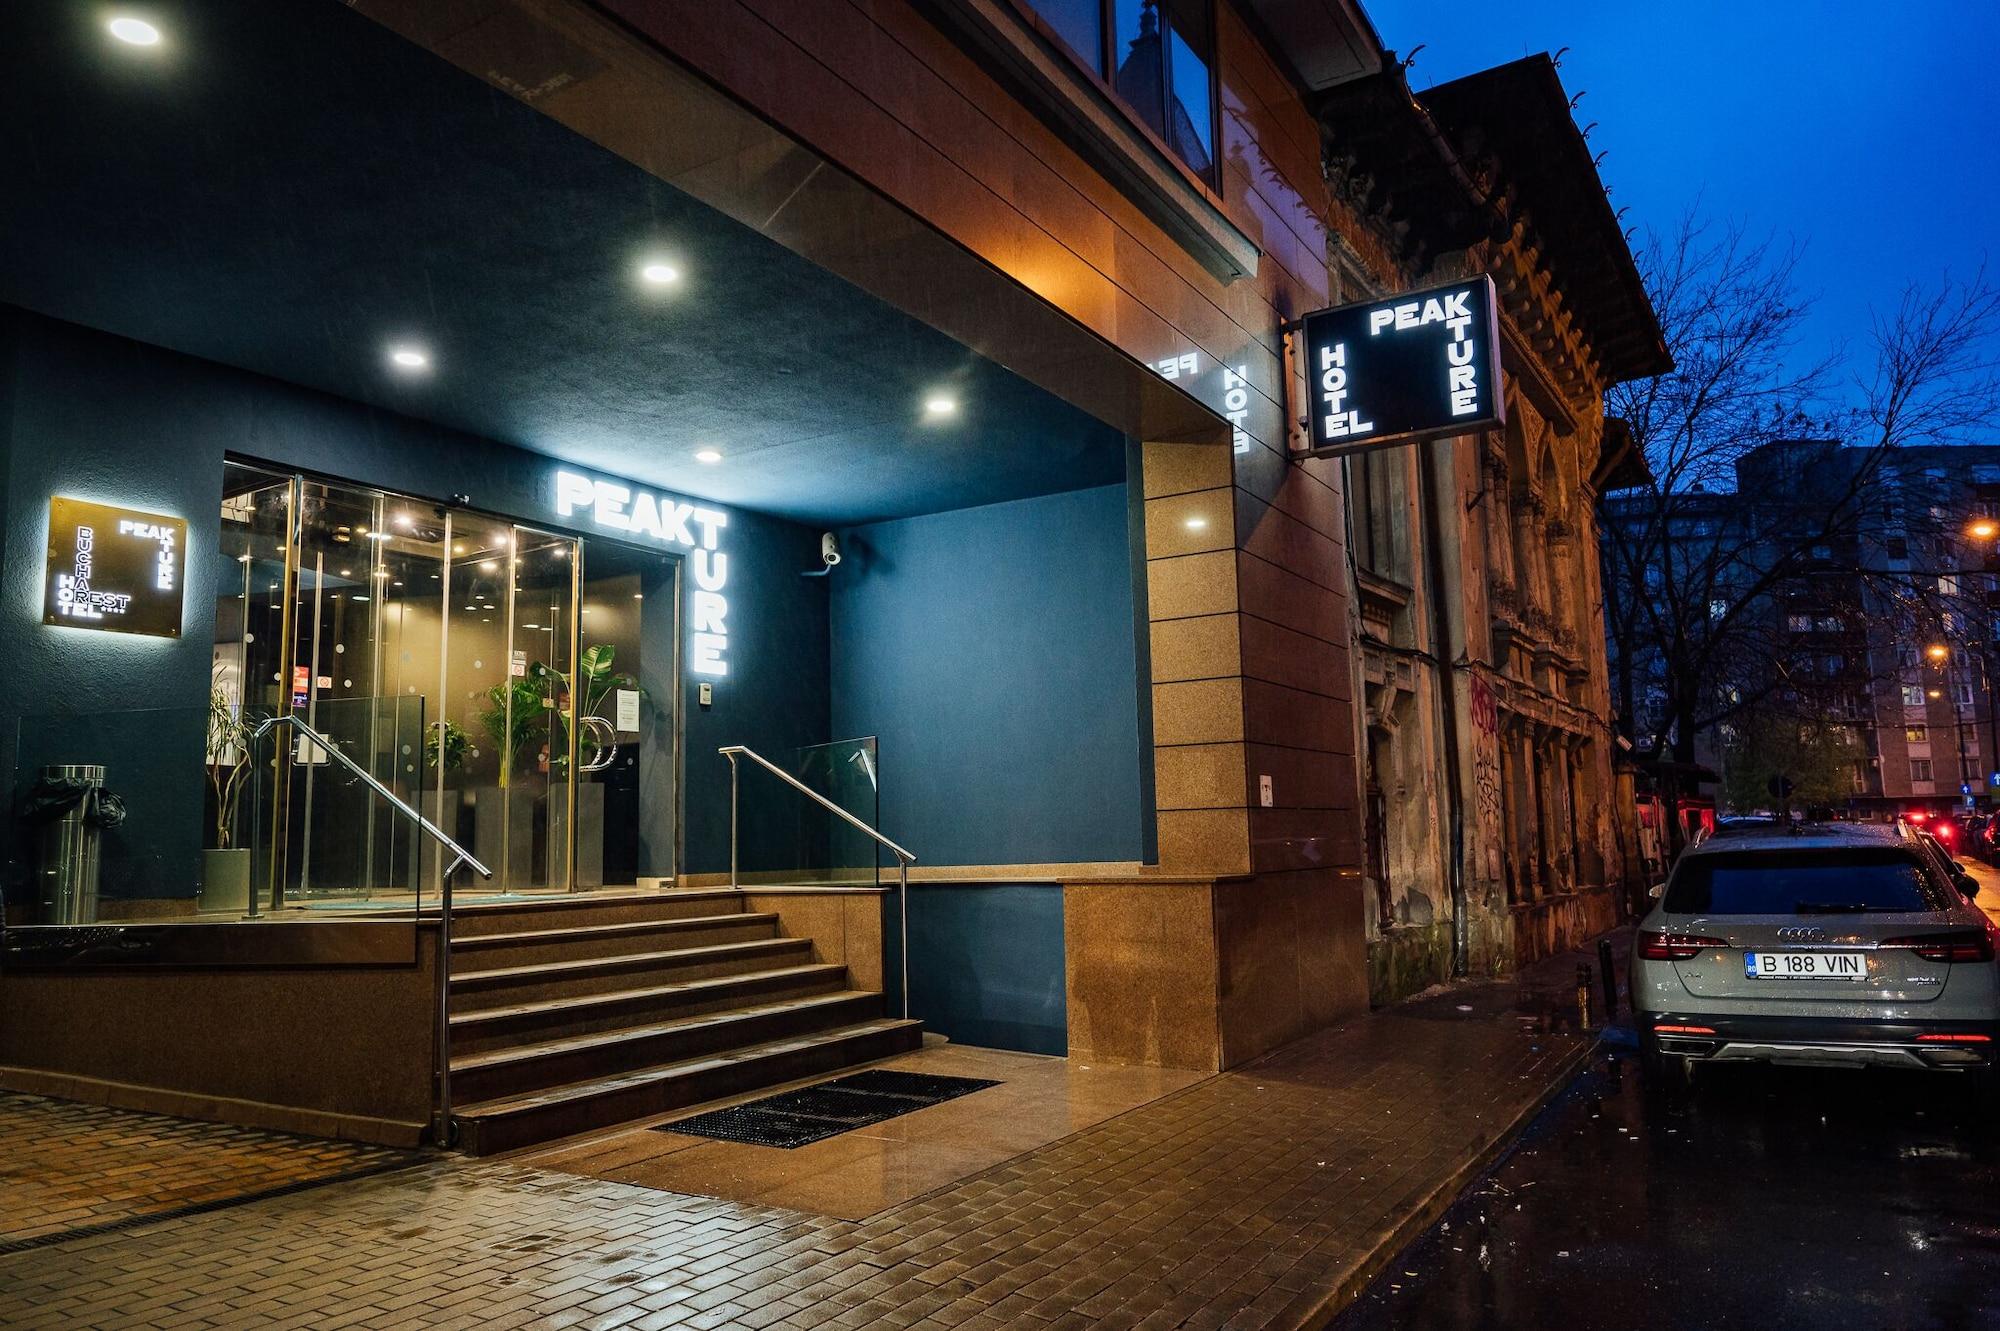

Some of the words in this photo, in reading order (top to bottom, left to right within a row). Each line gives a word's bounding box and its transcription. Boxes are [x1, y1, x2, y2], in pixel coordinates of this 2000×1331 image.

[1321, 343, 1373, 439] HOTEL
[1762, 956, 1777, 972] B
[1784, 956, 1815, 973] 188
[1824, 956, 1859, 973] VIN
